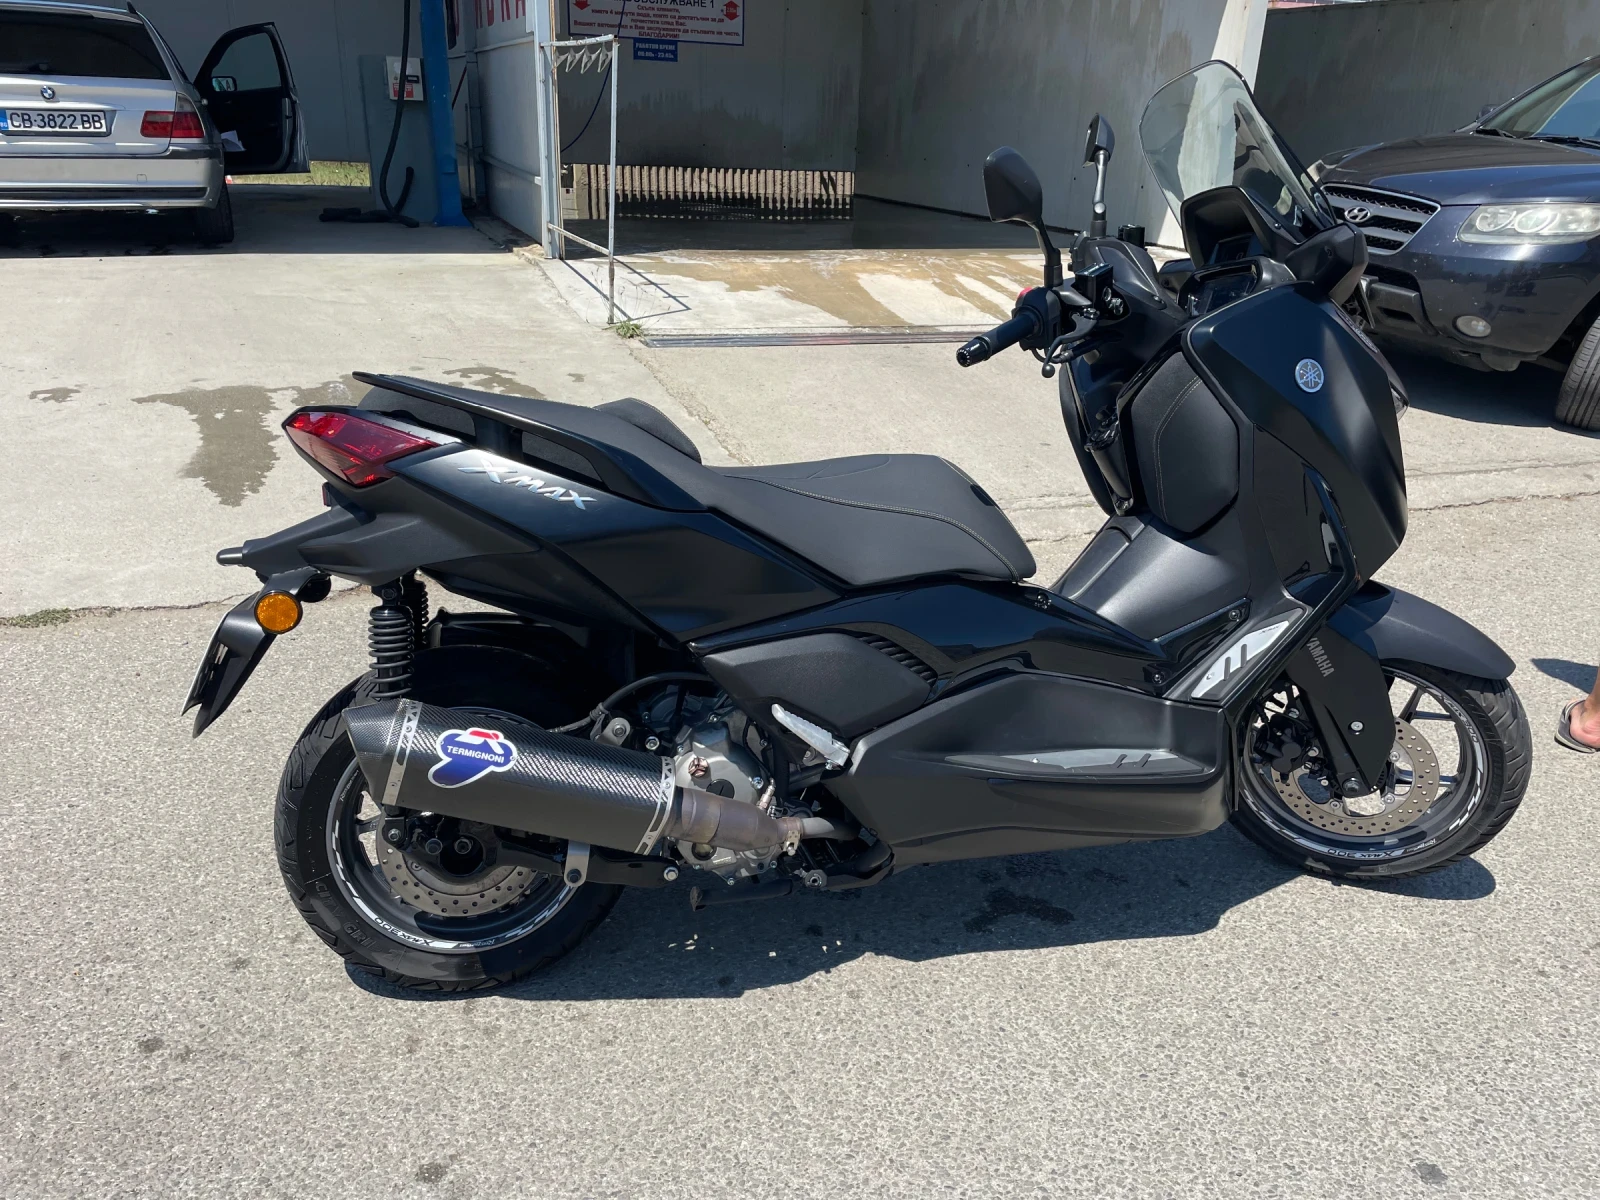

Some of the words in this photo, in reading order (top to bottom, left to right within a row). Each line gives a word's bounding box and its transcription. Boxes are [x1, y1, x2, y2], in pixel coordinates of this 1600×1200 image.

[639, 31, 679, 39] БЛАГОДАРИМ!
[80, 114, 103, 130] BB
[446, 745, 505, 765] TERMIGNONI
